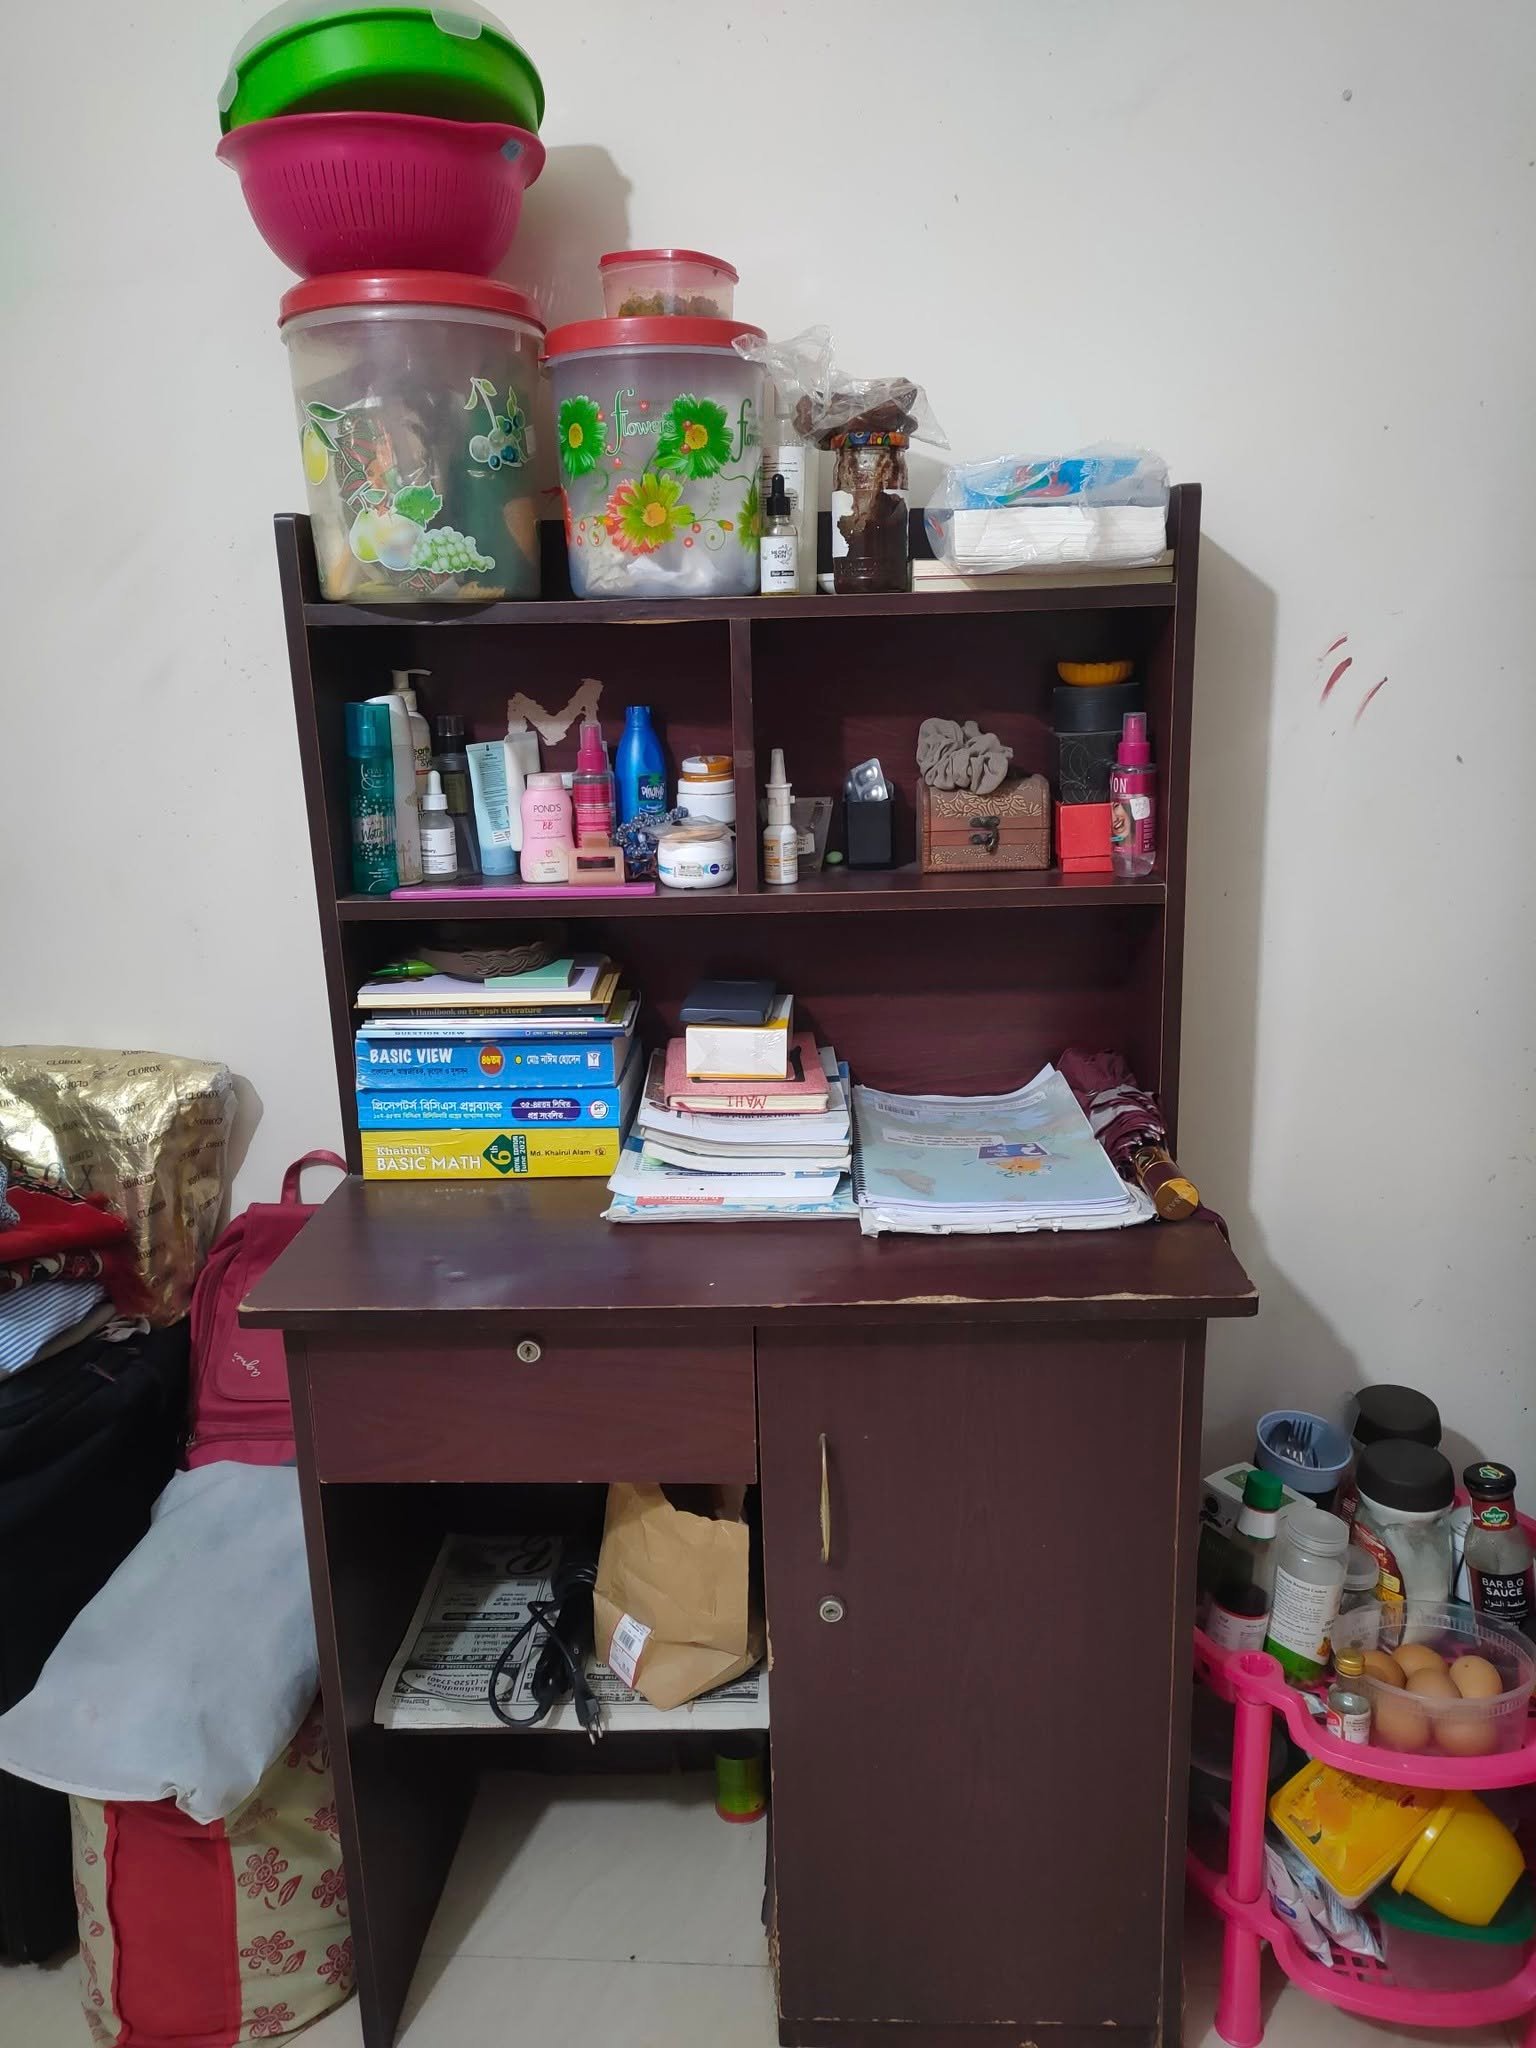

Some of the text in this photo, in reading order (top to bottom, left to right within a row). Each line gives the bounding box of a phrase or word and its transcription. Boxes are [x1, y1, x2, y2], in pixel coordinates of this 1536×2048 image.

[605, 389, 675, 456] flowers
[533, 803, 561, 813] POND'S
[415, 1008, 456, 1016] Handbook
[500, 1007, 542, 1015] Literature
[370, 1047, 453, 1064] BASIC VIEW
[127, 1064, 162, 1077] CLOROX
[185, 1090, 220, 1100] CLOROX
[371, 1098, 417, 1111] প্রিসেপটর্স
[420, 1098, 457, 1111] বিসিএস
[728, 1095, 768, 1109] MAHI
[377, 1146, 431, 1156] Khairul's
[544, 1149, 571, 1157] Khairul
[572, 1148, 591, 1156] Alam
[377, 1156, 481, 1171] BASIC MATH
[520, 1155, 528, 1172] June
[1481, 1577, 1525, 1589] BAR.B.Q
[1486, 1587, 1524, 1597] SAUCE
